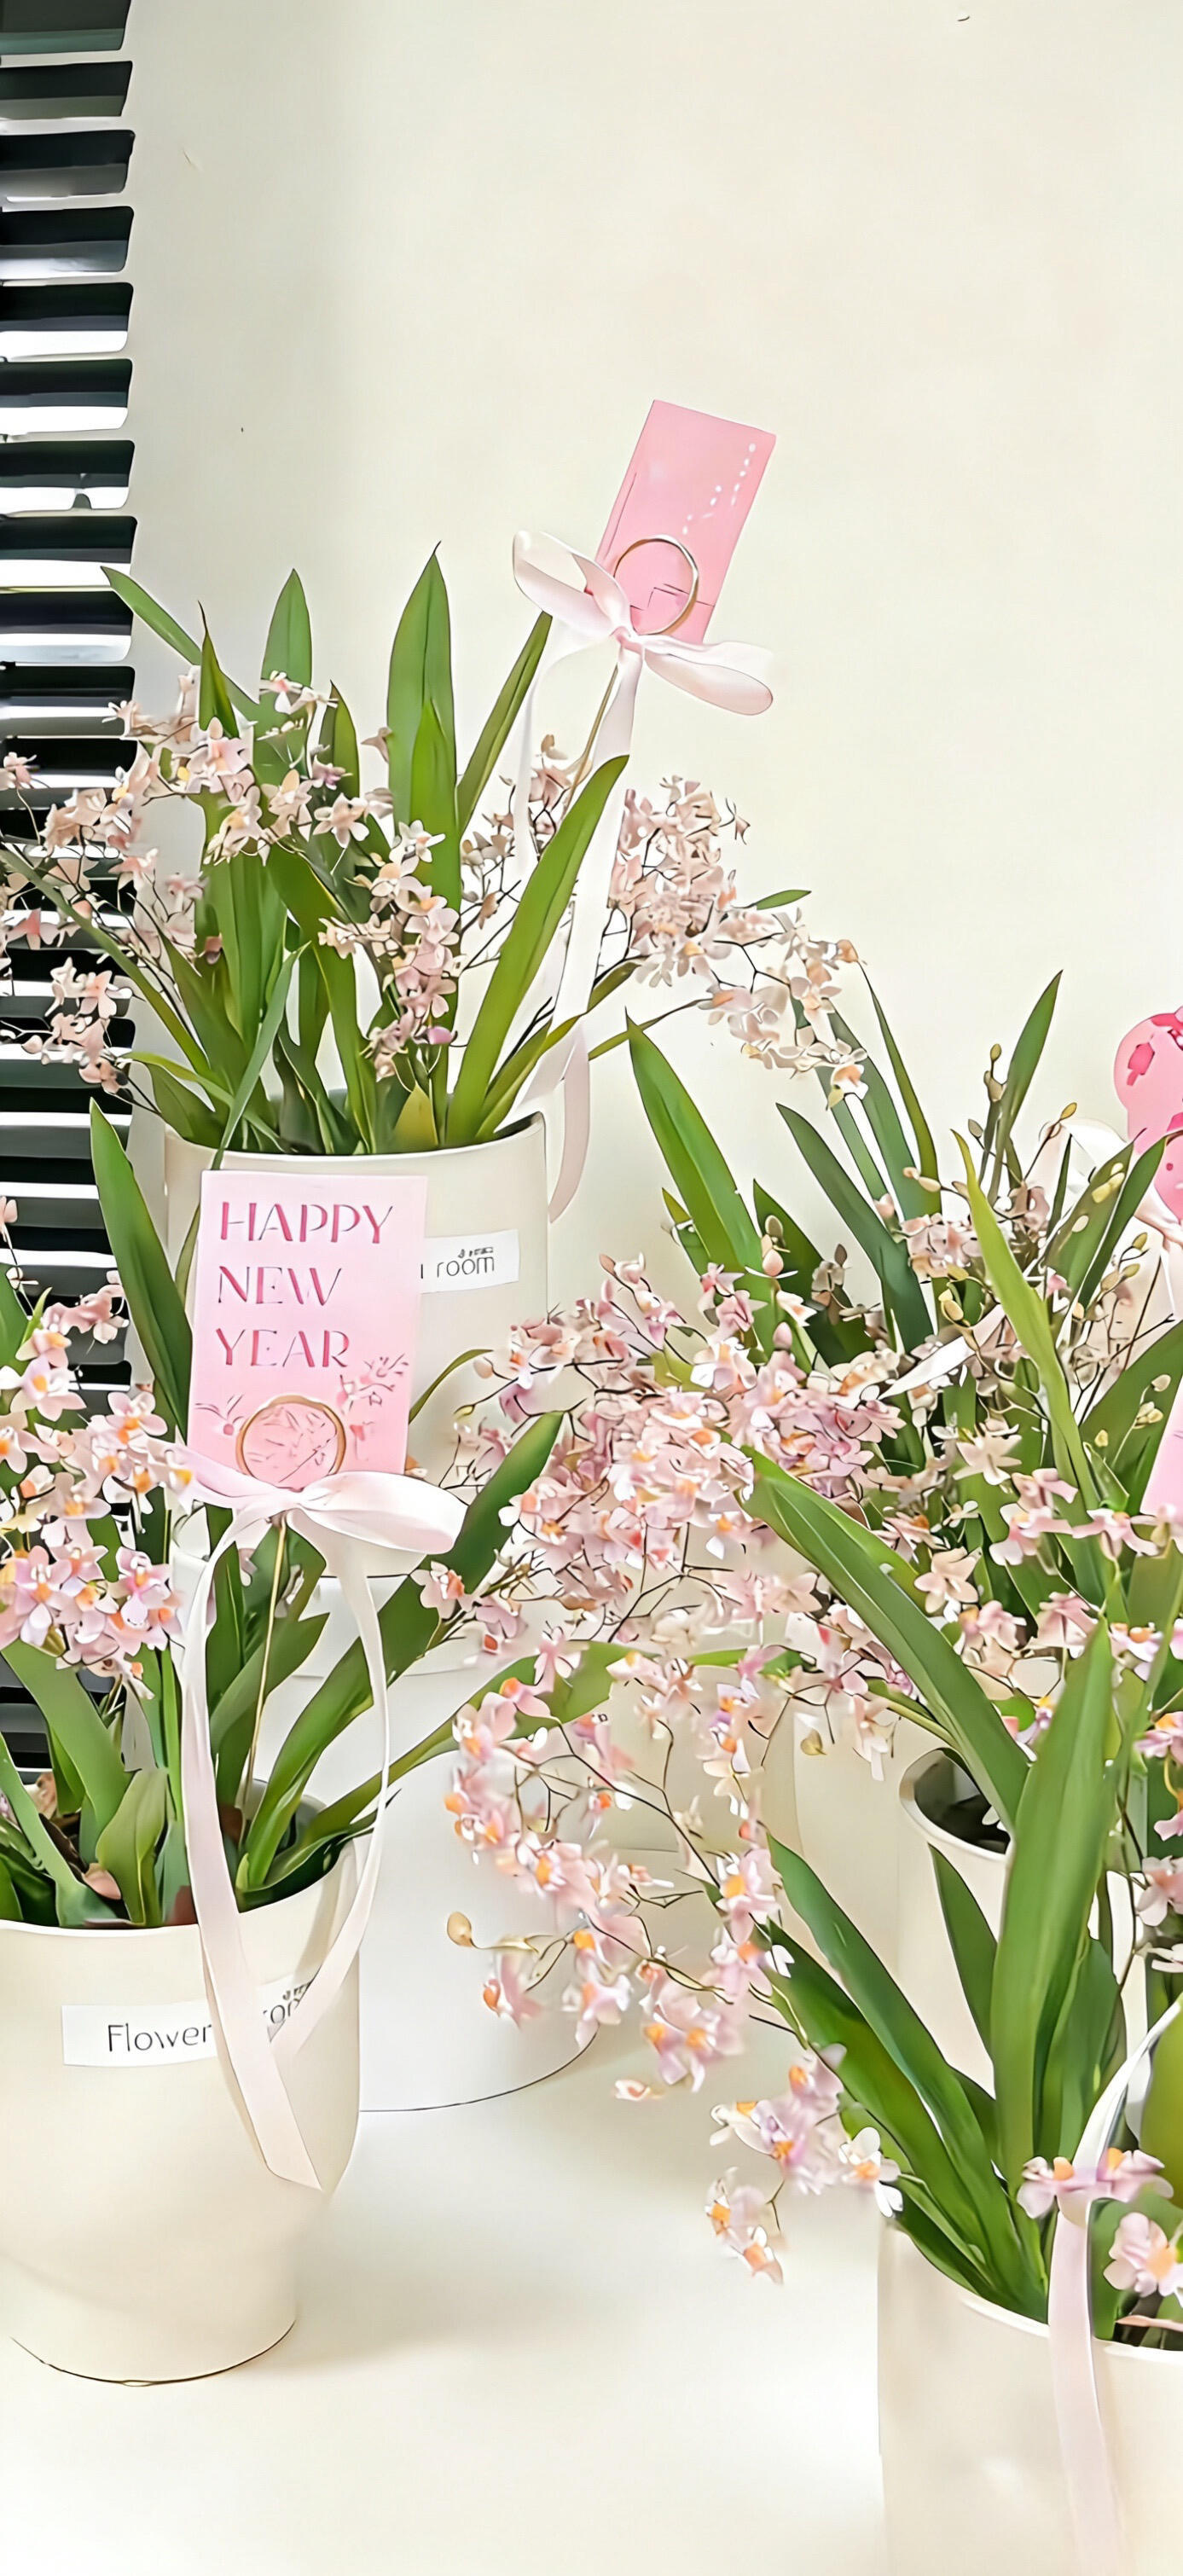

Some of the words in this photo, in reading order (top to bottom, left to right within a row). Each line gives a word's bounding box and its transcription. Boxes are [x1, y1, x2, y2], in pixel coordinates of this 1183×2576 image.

[220, 1202, 393, 1244] HAPPY
[217, 1265, 342, 1306] NEW
[437, 1256, 495, 1278] room
[215, 1328, 350, 1367] YEAR
[107, 2022, 212, 2052] Flower
